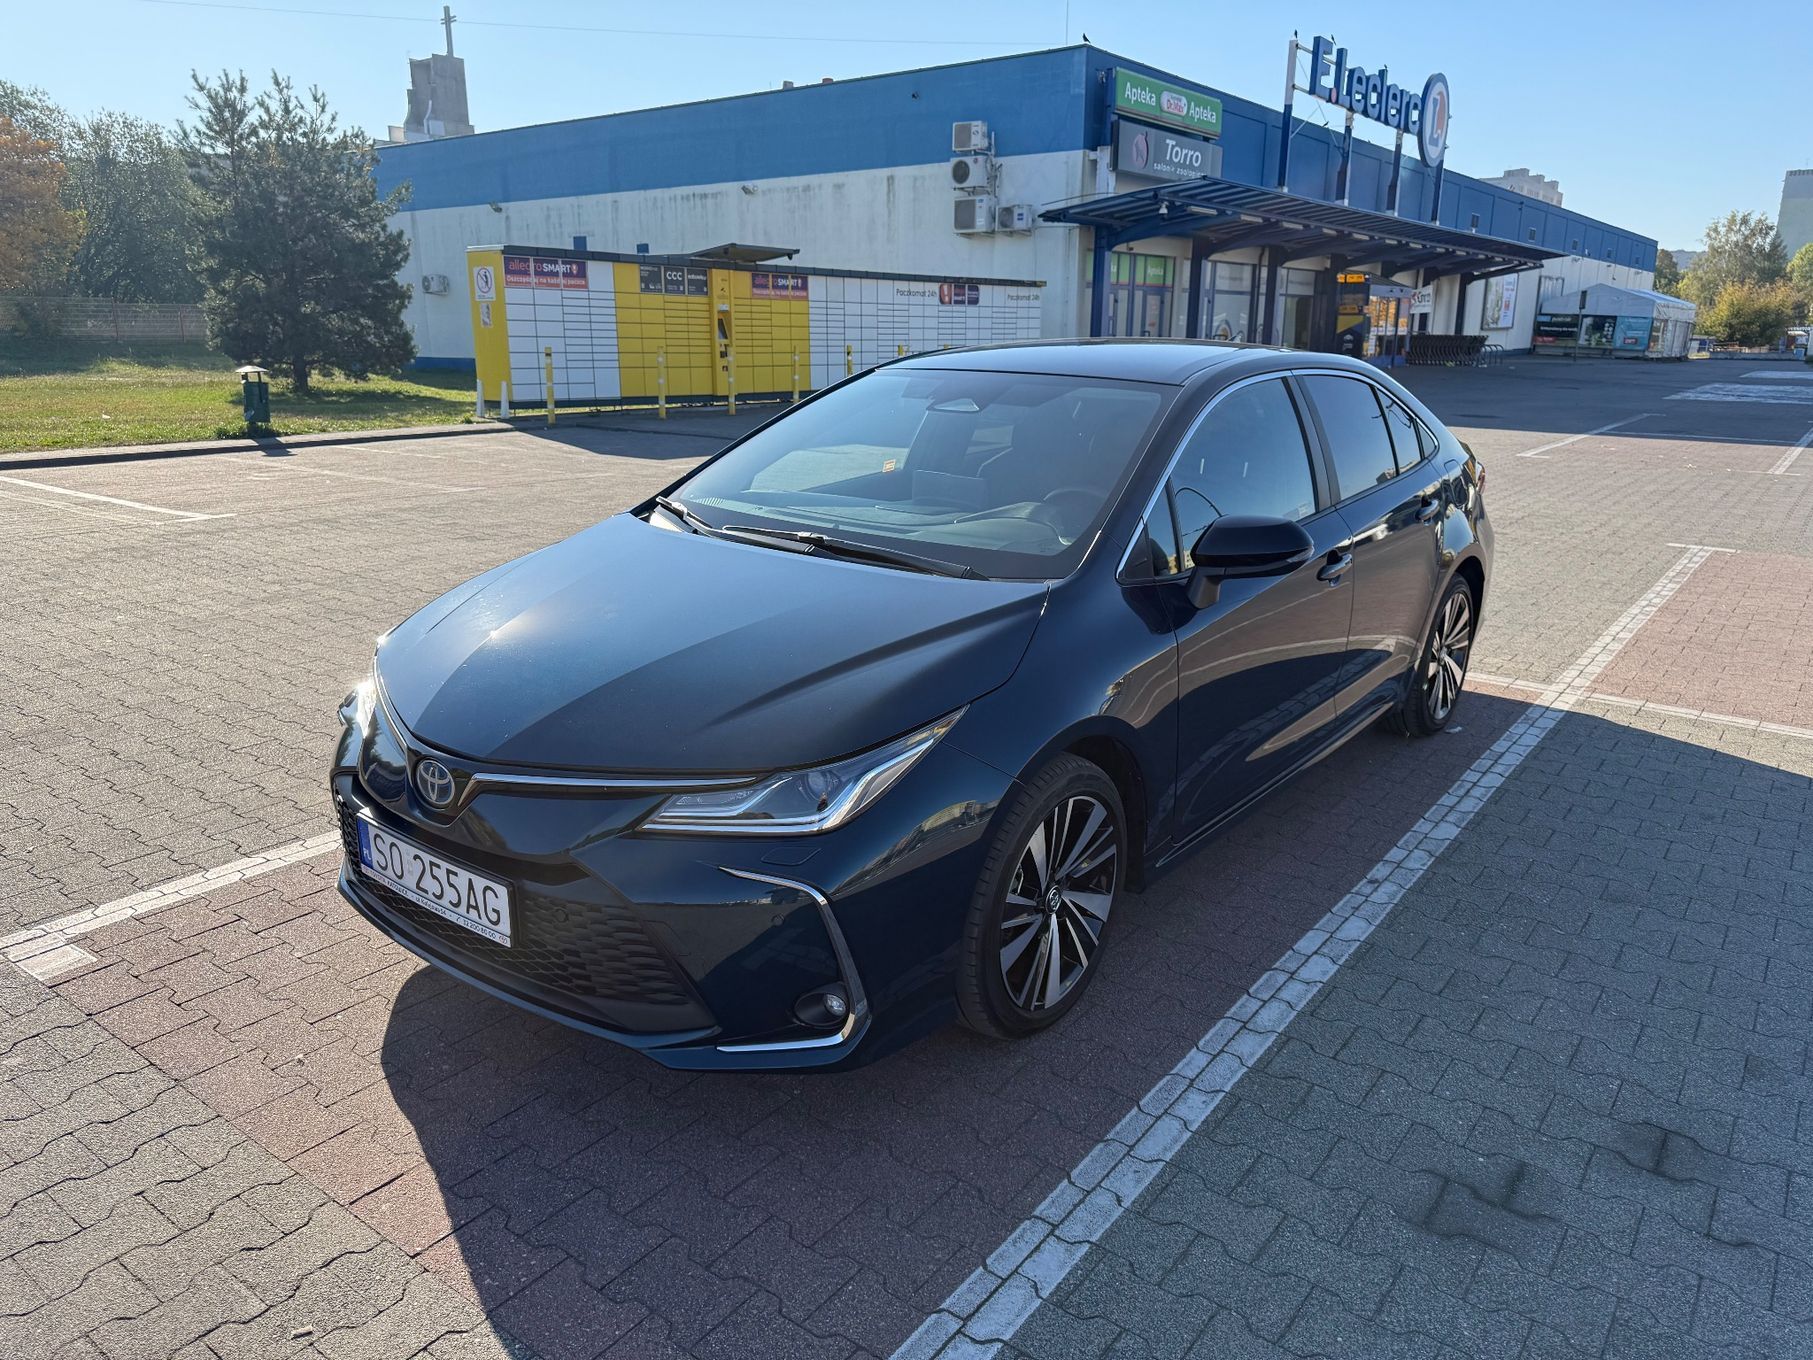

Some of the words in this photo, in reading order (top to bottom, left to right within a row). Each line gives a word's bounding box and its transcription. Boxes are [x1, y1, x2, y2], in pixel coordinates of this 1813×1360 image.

[1125, 81, 1156, 106] Apteka
[1189, 101, 1216, 123] Apteka
[1166, 138, 1202, 167] Torro
[543, 263, 571, 273] SMART
[666, 271, 682, 281] CCC
[373, 833, 404, 880] SO
[413, 853, 501, 926] 255AG
